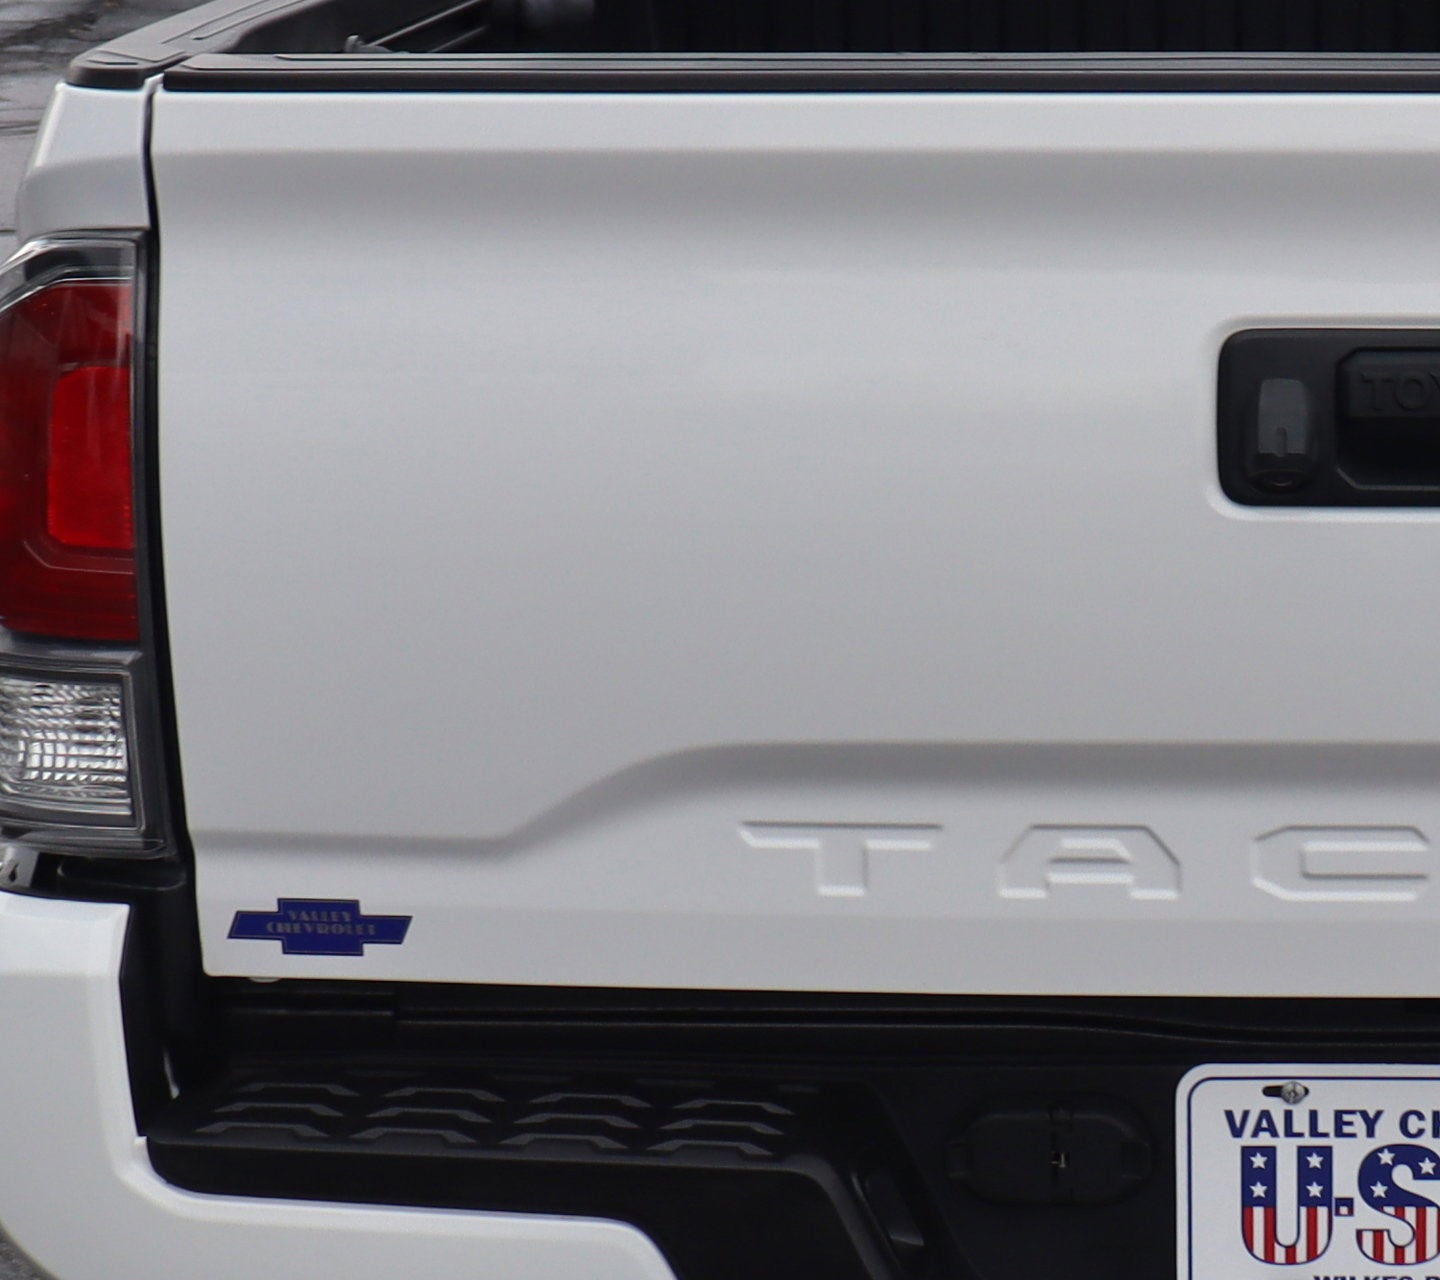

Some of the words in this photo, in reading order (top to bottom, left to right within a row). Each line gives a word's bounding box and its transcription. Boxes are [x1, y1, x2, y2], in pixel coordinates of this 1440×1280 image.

[287, 909, 353, 923] VALLEY
[266, 922, 377, 936] CHEVROLET
[1225, 1109, 1386, 1140] VALLEY
